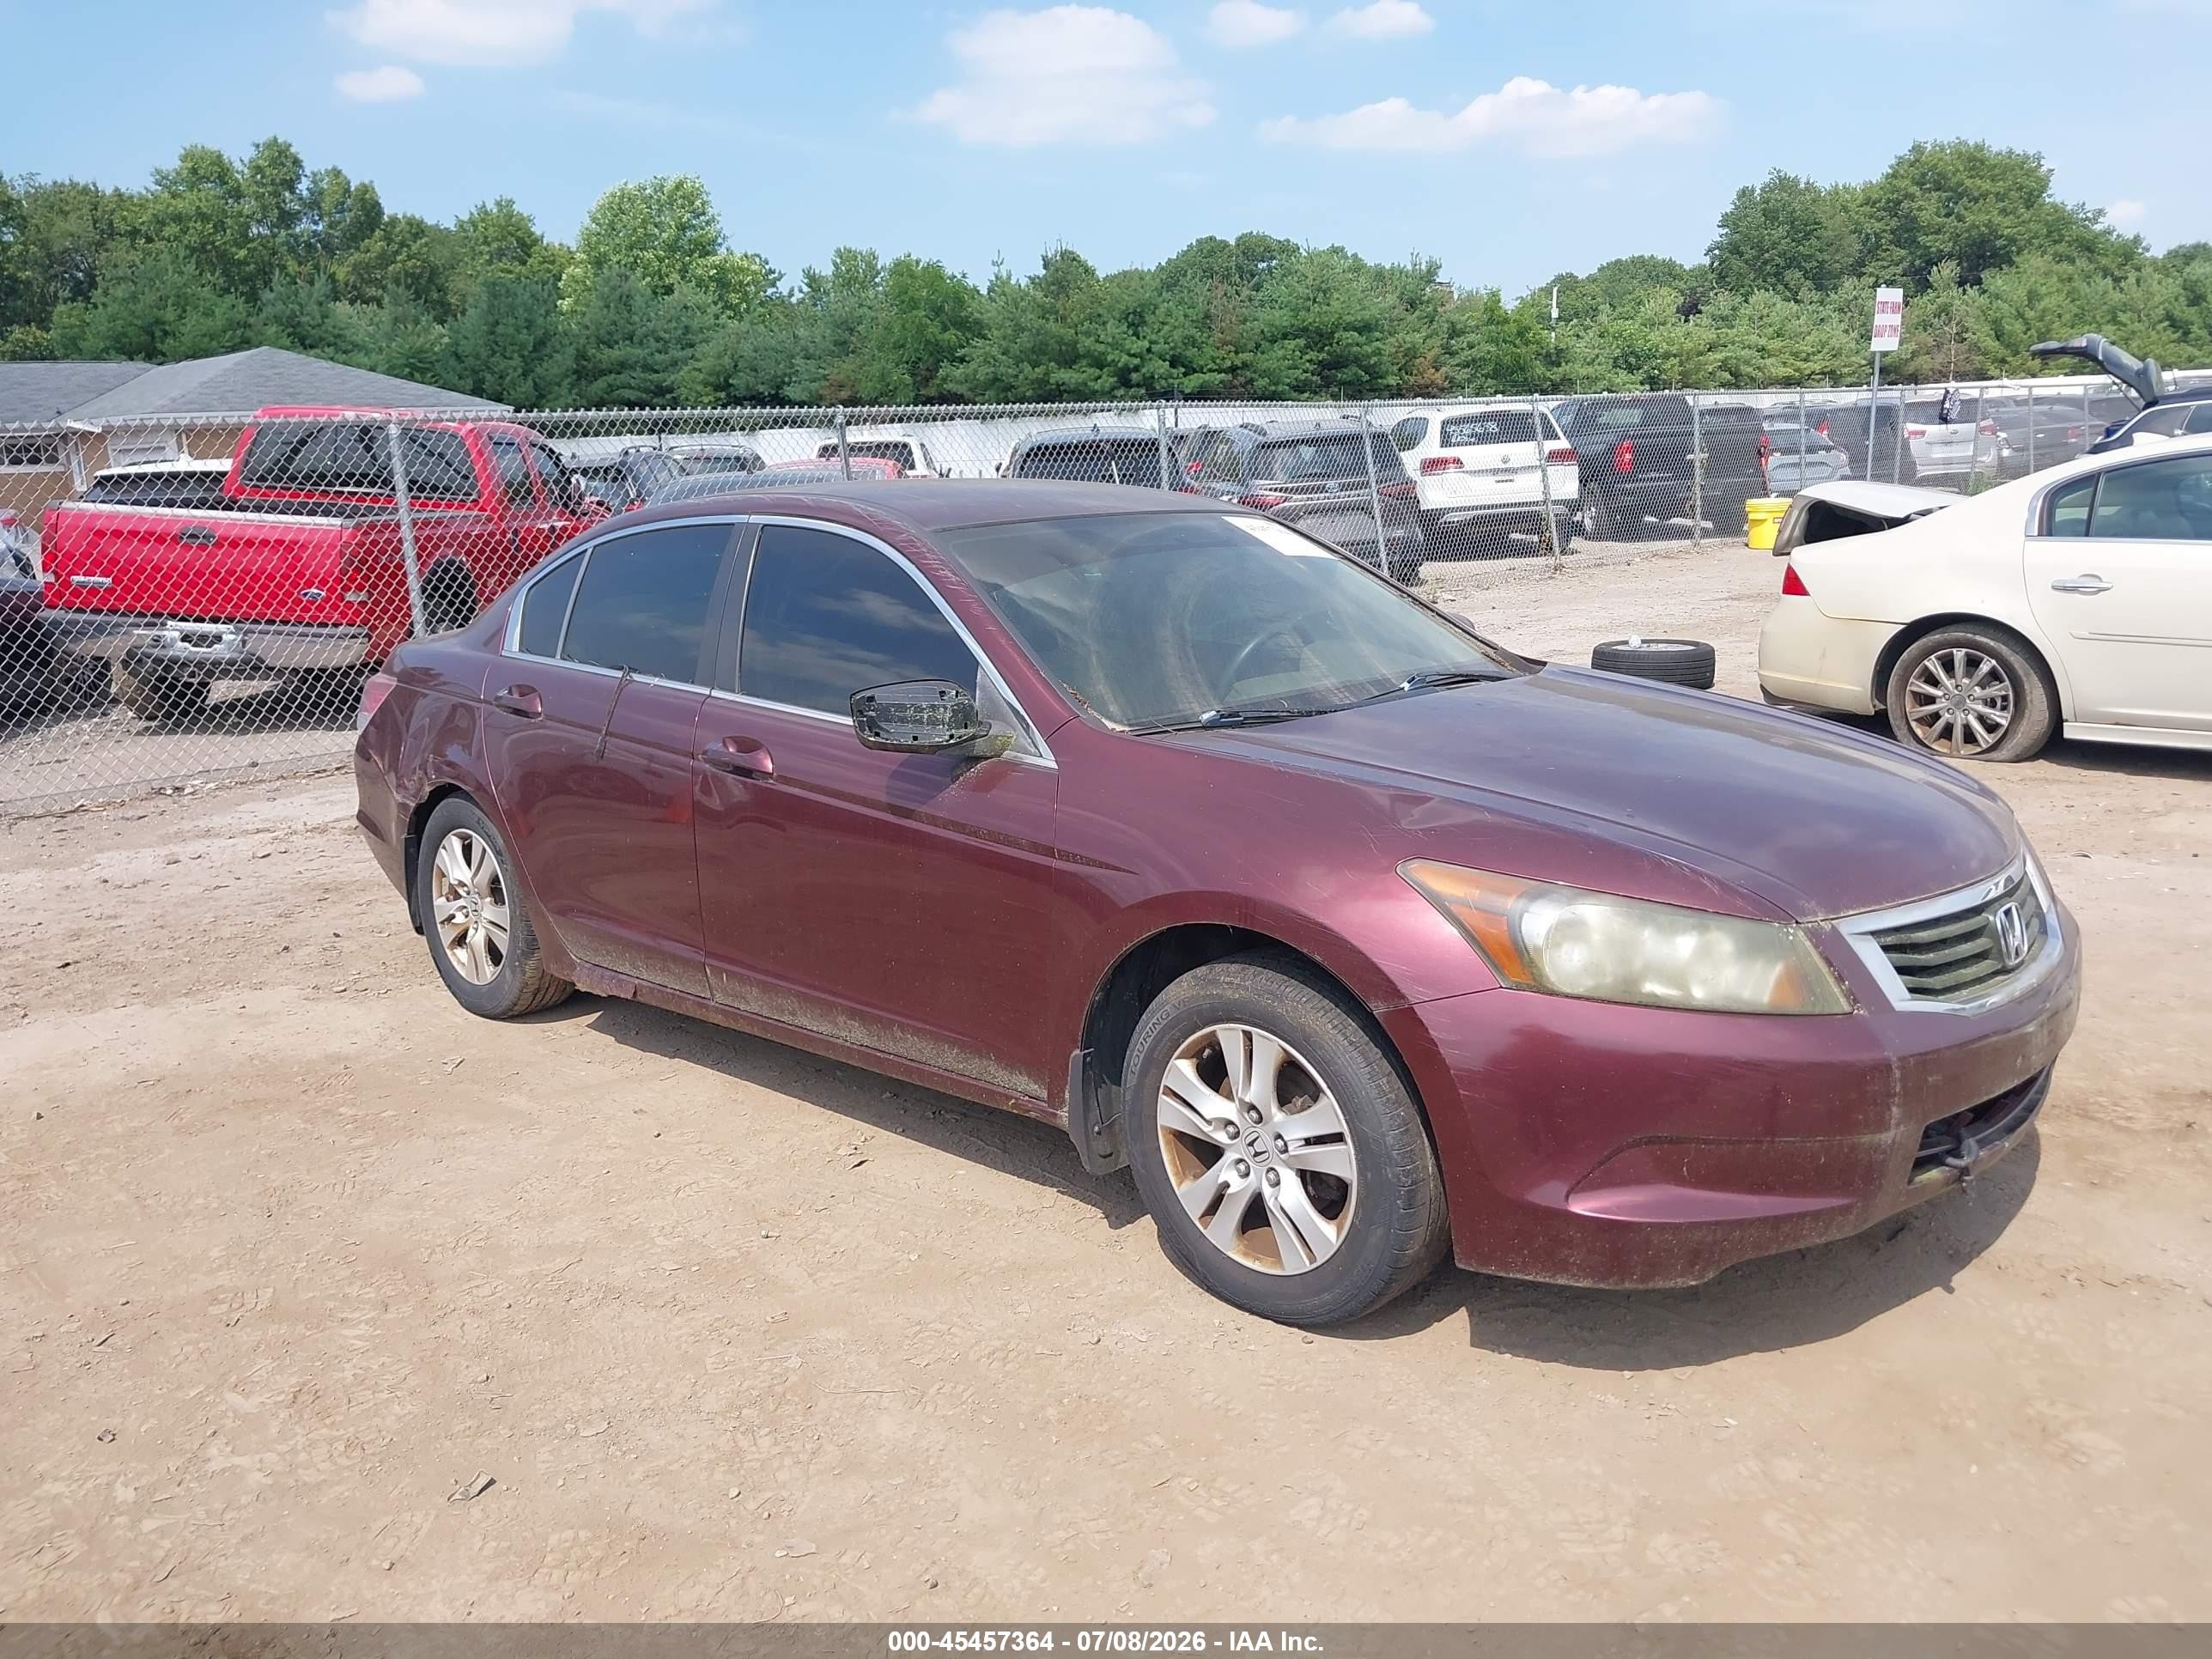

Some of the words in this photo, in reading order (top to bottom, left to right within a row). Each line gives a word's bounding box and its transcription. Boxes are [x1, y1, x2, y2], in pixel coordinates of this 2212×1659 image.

[1876, 301, 1889, 314] STATE
[1889, 301, 1901, 314] FARM
[1874, 324, 1887, 337] DROP
[1887, 324, 1899, 337] ZONE
[1130, 1009, 1170, 1076] TOURING
